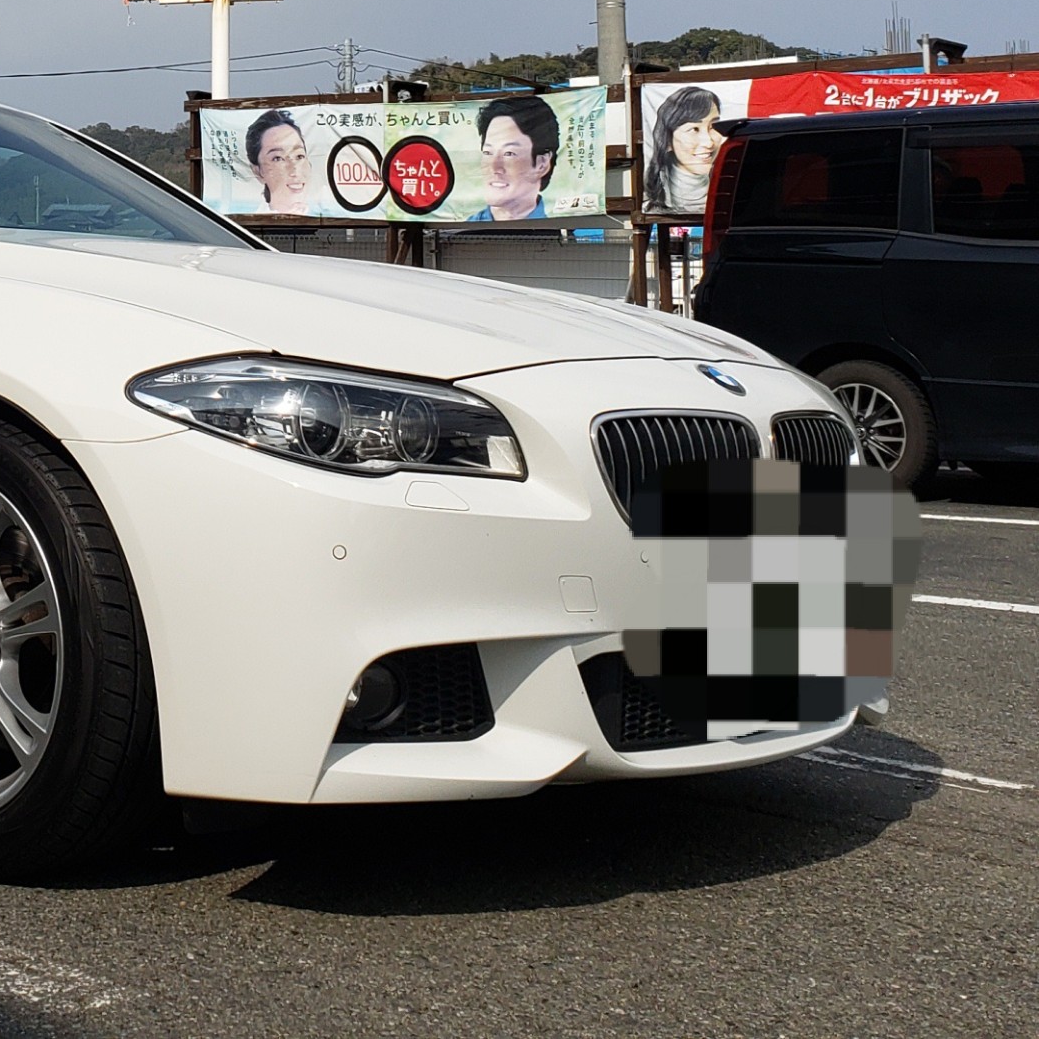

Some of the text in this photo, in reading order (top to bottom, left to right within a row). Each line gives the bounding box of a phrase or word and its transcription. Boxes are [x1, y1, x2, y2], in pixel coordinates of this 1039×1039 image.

[824, 84, 1000, 109] 2台に1台がブリザック
[316, 111, 472, 127] この実感が、ちゃんと買い。
